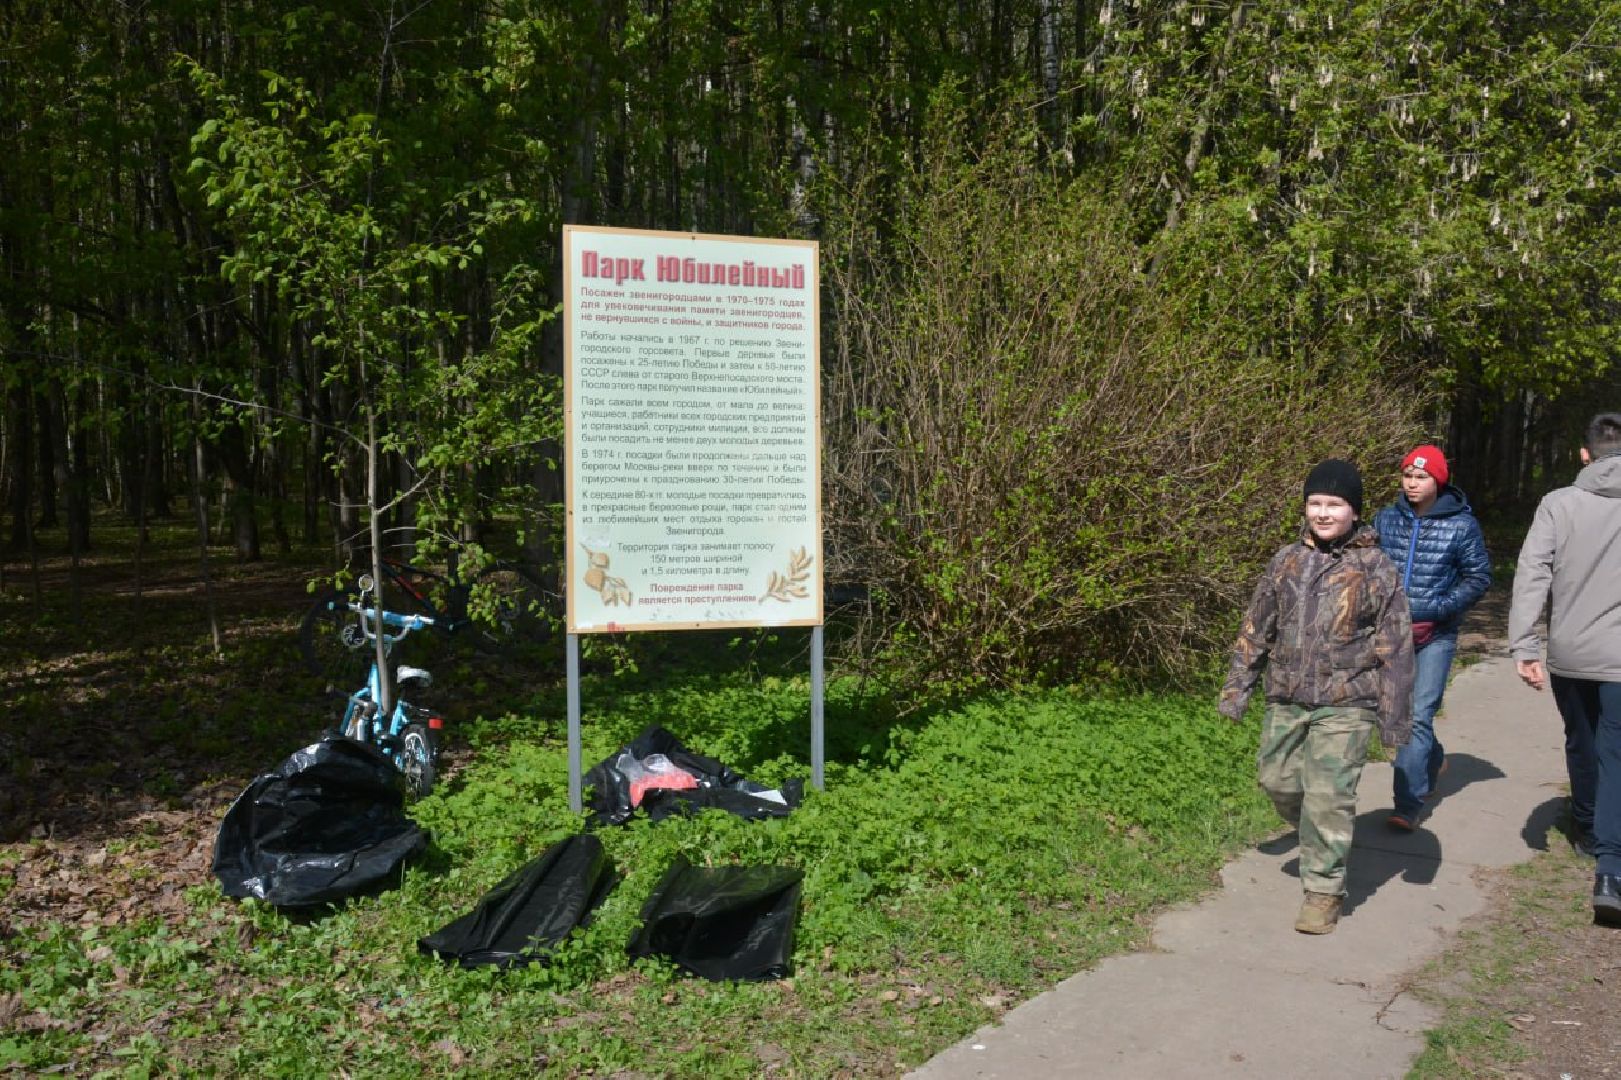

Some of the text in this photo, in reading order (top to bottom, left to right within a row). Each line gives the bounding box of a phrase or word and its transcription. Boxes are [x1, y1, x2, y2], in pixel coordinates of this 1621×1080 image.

[582, 250, 805, 289] Парк Юбилейный
[581, 287, 624, 298] Посажен
[630, 291, 711, 305] звенигородцами
[716, 295, 721, 303] в
[780, 298, 805, 309] годах
[581, 300, 600, 311] для
[691, 305, 725, 315] памяти
[581, 313, 592, 321] не
[596, 313, 659, 326] вернувшихся
[662, 316, 668, 324] с
[706, 318, 712, 326] и
[715, 319, 769, 330] защитников
[581, 330, 615, 341] Работы
[621, 334, 663, 343] начались
[668, 335, 673, 343] в
[680, 334, 700, 344] 1967
[714, 337, 725, 345] по
[729, 338, 772, 349] решению
[581, 344, 631, 356] городского
[695, 346, 729, 359] Первые
[737, 350, 775, 360] деревья
[782, 349, 806, 359] были
[581, 356, 626, 366] посажены
[630, 358, 635, 366] к
[638, 356, 680, 367] 25-летию
[683, 358, 718, 370] Победы
[720, 361, 726, 369] и
[729, 361, 754, 369] затем
[758, 362, 762, 370] к
[581, 367, 609, 378] СССР
[642, 371, 652, 379] от
[654, 371, 688, 382] старого
[581, 379, 610, 389] После
[612, 382, 635, 390] этого
[637, 382, 657, 393] парк
[659, 383, 695, 394] получил
[697, 384, 738, 393] название
[581, 396, 605, 408] Парк
[608, 398, 643, 407] сажали
[717, 401, 728, 409] от
[730, 401, 753, 409] мала
[758, 402, 768, 412] до
[581, 408, 806, 423] учащиеся, работники всех городских предприятий
[581, 422, 587, 430] и
[653, 423, 705, 434] сотрудники
[770, 426, 806, 436] должны
[581, 432, 606, 442] были
[609, 434, 650, 445] посадить
[653, 435, 663, 443] не
[666, 435, 695, 443] менее
[696, 436, 716, 446] двух
[719, 436, 759, 446] молодых
[581, 449, 588, 459] В
[592, 449, 614, 459] 1974
[626, 451, 663, 461] посадки
[666, 450, 691, 459] были
[790, 453, 807, 462] над
[581, 460, 620, 472] берегом
[625, 461, 683, 473] Москвы-реки
[688, 463, 713, 473] вверх
[773, 464, 778, 472] и
[783, 463, 806, 472] были
[582, 475, 640, 485] приурочены
[643, 475, 648, 483] к
[651, 475, 720, 485] празднованию
[582, 489, 588, 499] К
[590, 491, 634, 501] середине
[635, 489, 653, 499] 80-х
[666, 491, 707, 501] молодые
[709, 491, 745, 501] посадки
[746, 491, 807, 501] превратились
[582, 504, 587, 512] в
[591, 504, 646, 514] прекрасные
[732, 503, 752, 513] парк
[755, 503, 775, 511] стал
[779, 503, 807, 513] одним
[582, 515, 593, 523] из
[598, 513, 658, 523] любимейших
[663, 515, 685, 523] мест
[690, 515, 721, 525] отдыха
[728, 515, 764, 524] горожан
[778, 513, 807, 522] гостей
[618, 541, 775, 553] Территория парка занимает полосу
[651, 552, 743, 565] 150 метров шириной
[642, 567, 647, 575] и
[666, 566, 713, 577] километра
[716, 566, 720, 574] в
[650, 582, 744, 594] Повреждение парка
[639, 594, 756, 605] является преступлением
